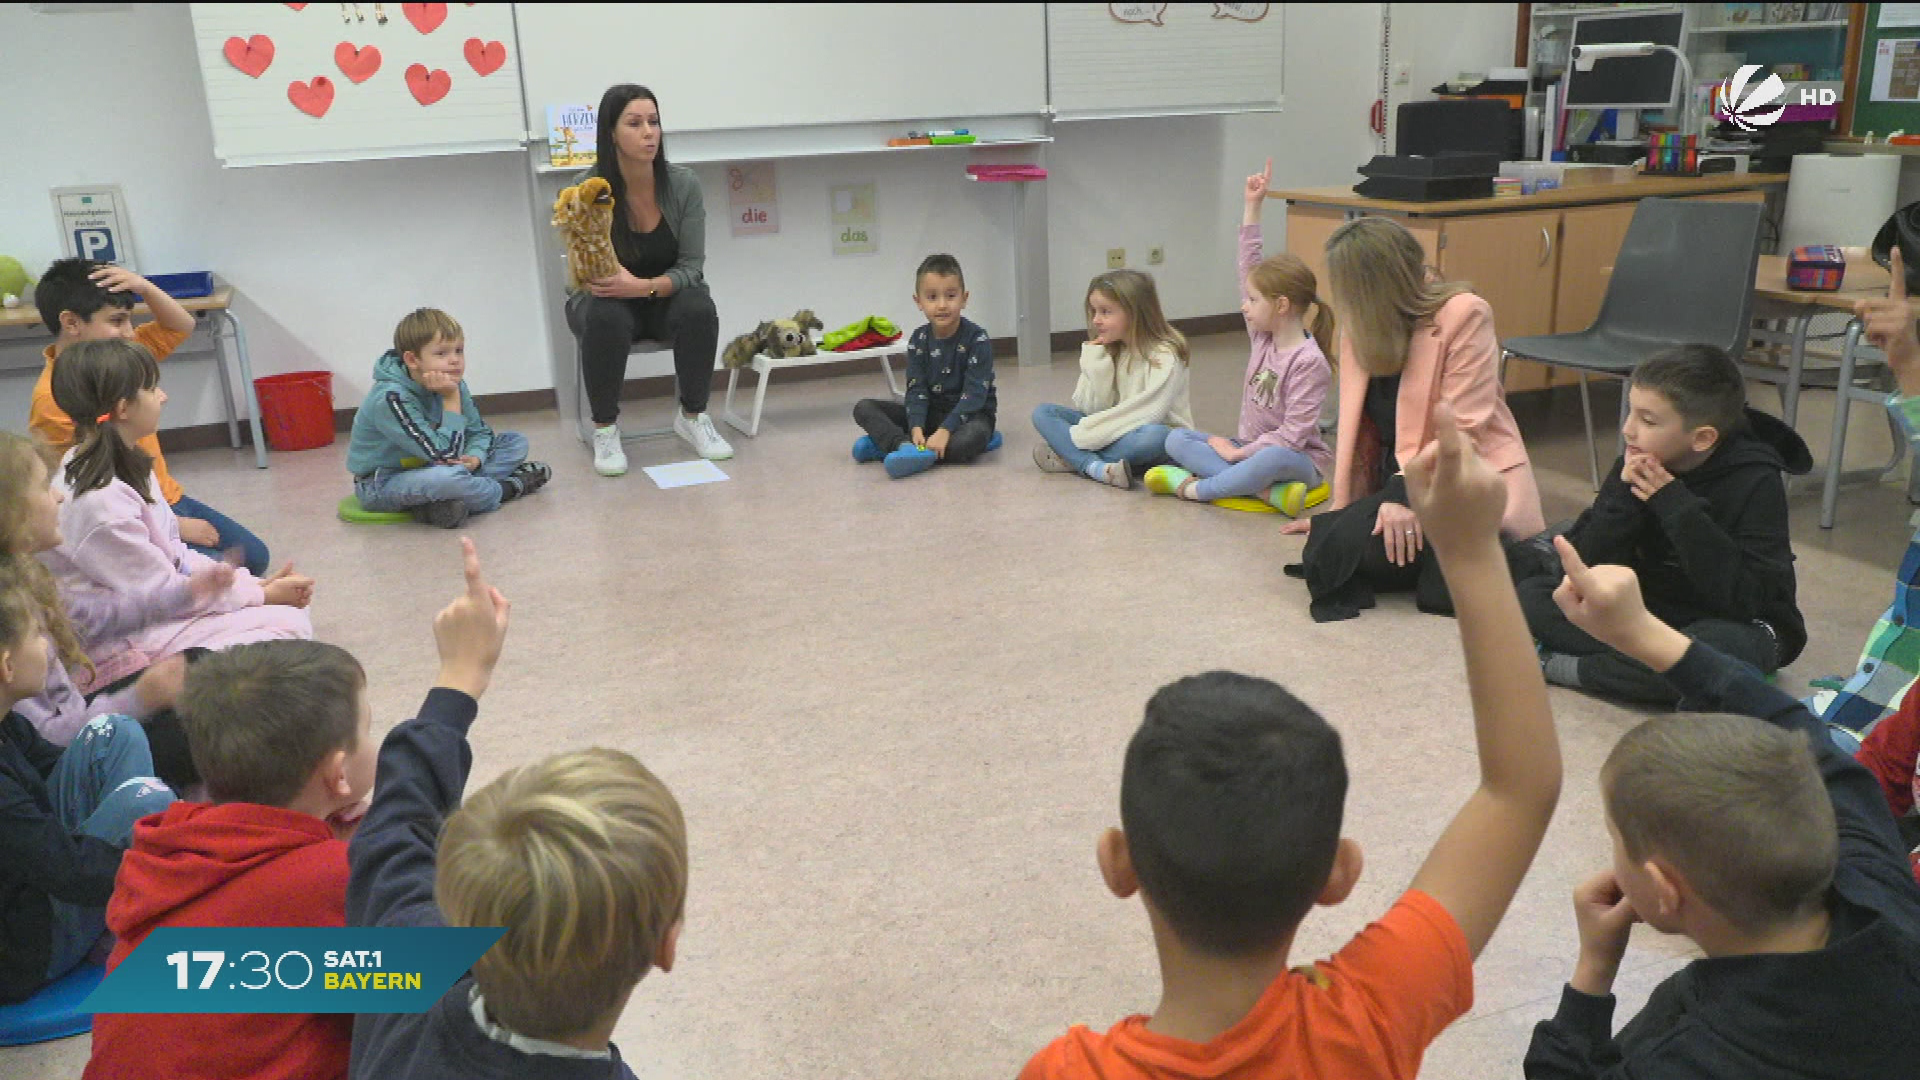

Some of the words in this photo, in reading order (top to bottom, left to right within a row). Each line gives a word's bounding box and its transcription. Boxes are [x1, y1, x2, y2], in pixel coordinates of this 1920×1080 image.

[741, 209, 768, 224] die
[841, 227, 868, 243] das
[80, 231, 108, 260] P
